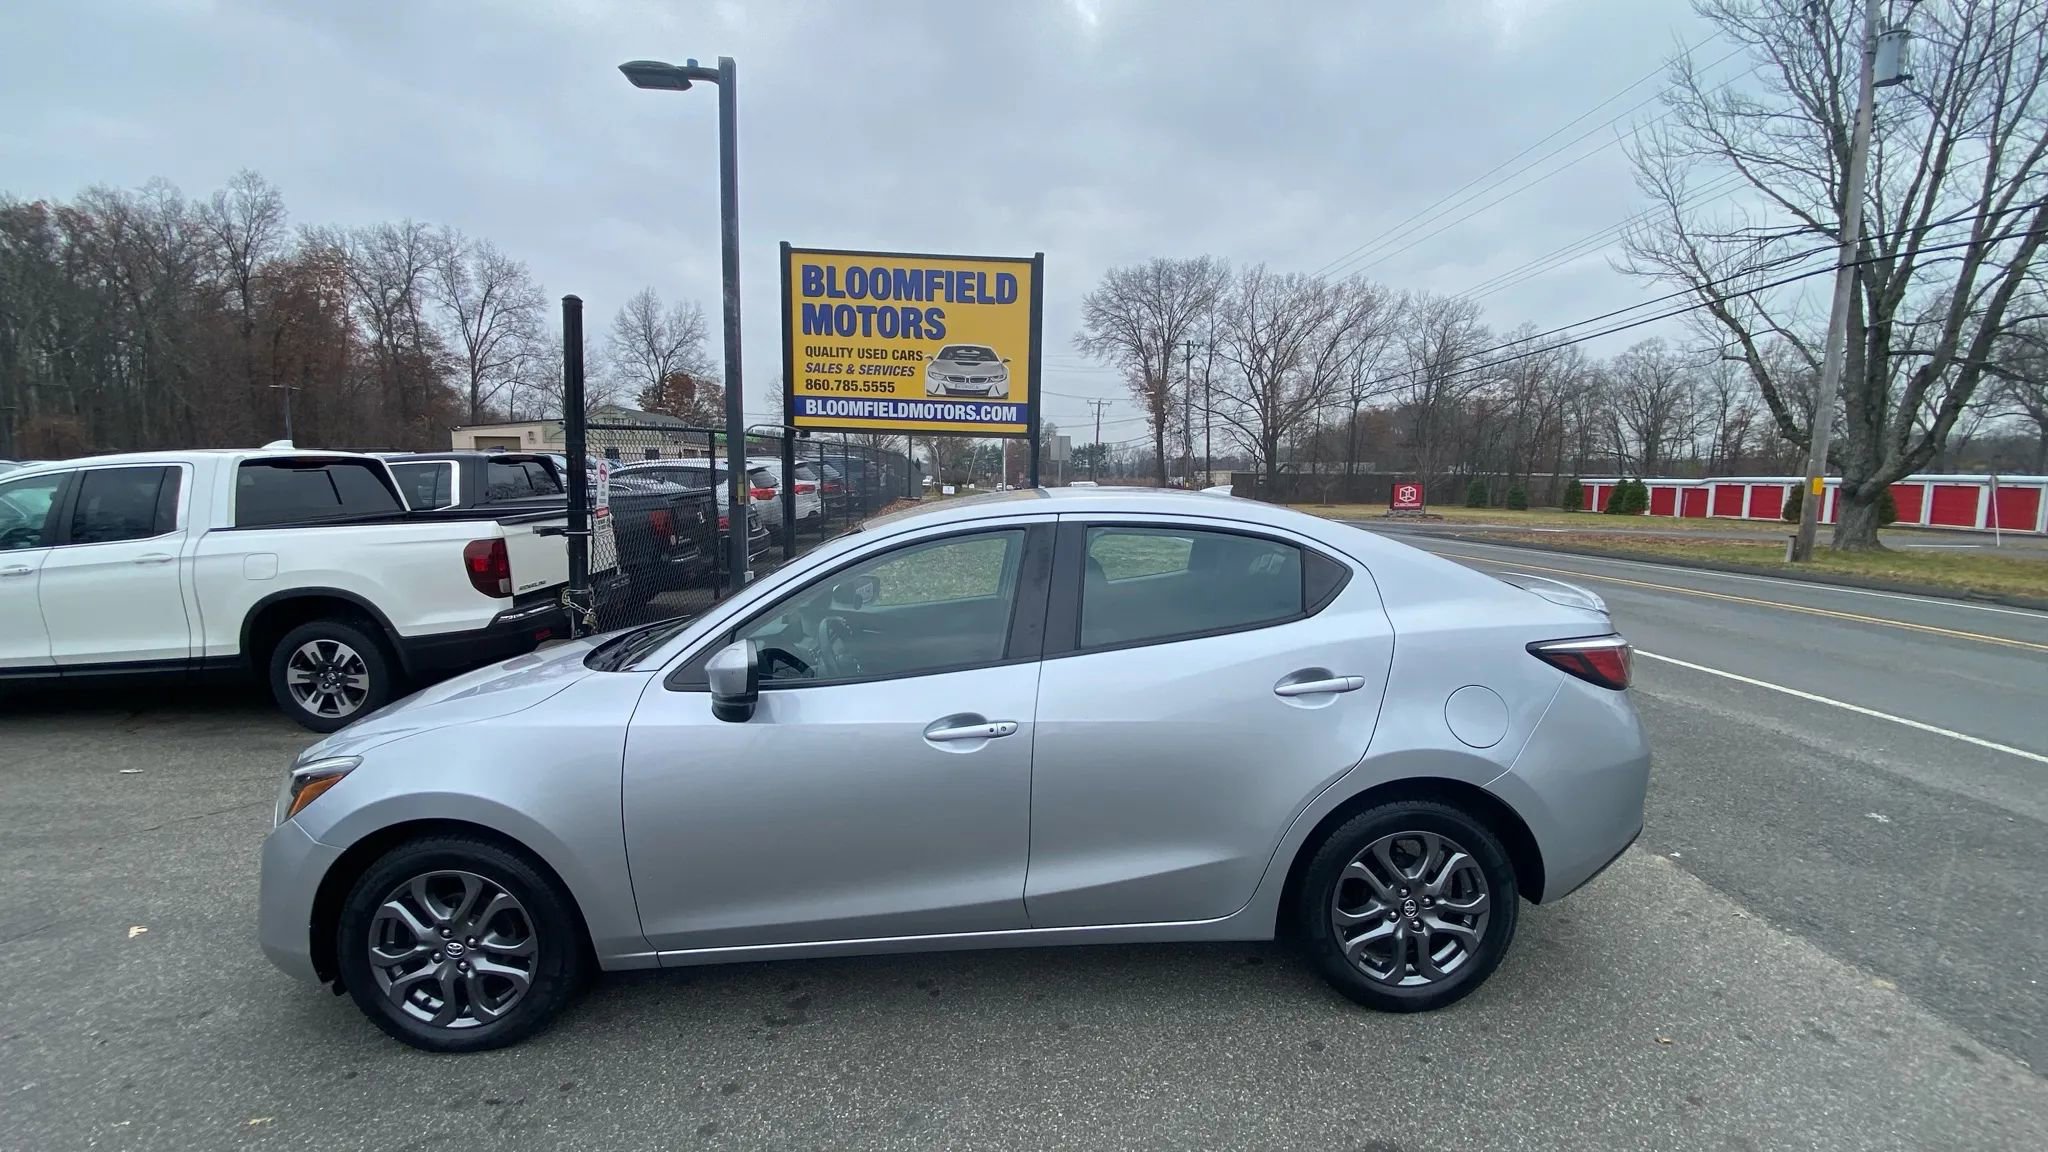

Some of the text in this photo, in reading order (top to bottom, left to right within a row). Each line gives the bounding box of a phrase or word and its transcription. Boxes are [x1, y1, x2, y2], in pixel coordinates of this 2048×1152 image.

[802, 264, 1018, 305] BLOOMFIELD
[802, 303, 947, 340] MOTORS
[805, 345, 923, 361] QUALITY USED CARS
[805, 362, 915, 377] SALES & SERVICES
[805, 378, 896, 393] 860.785.5555
[805, 399, 1017, 422] BLOOMFIELDMOTORS.COM
